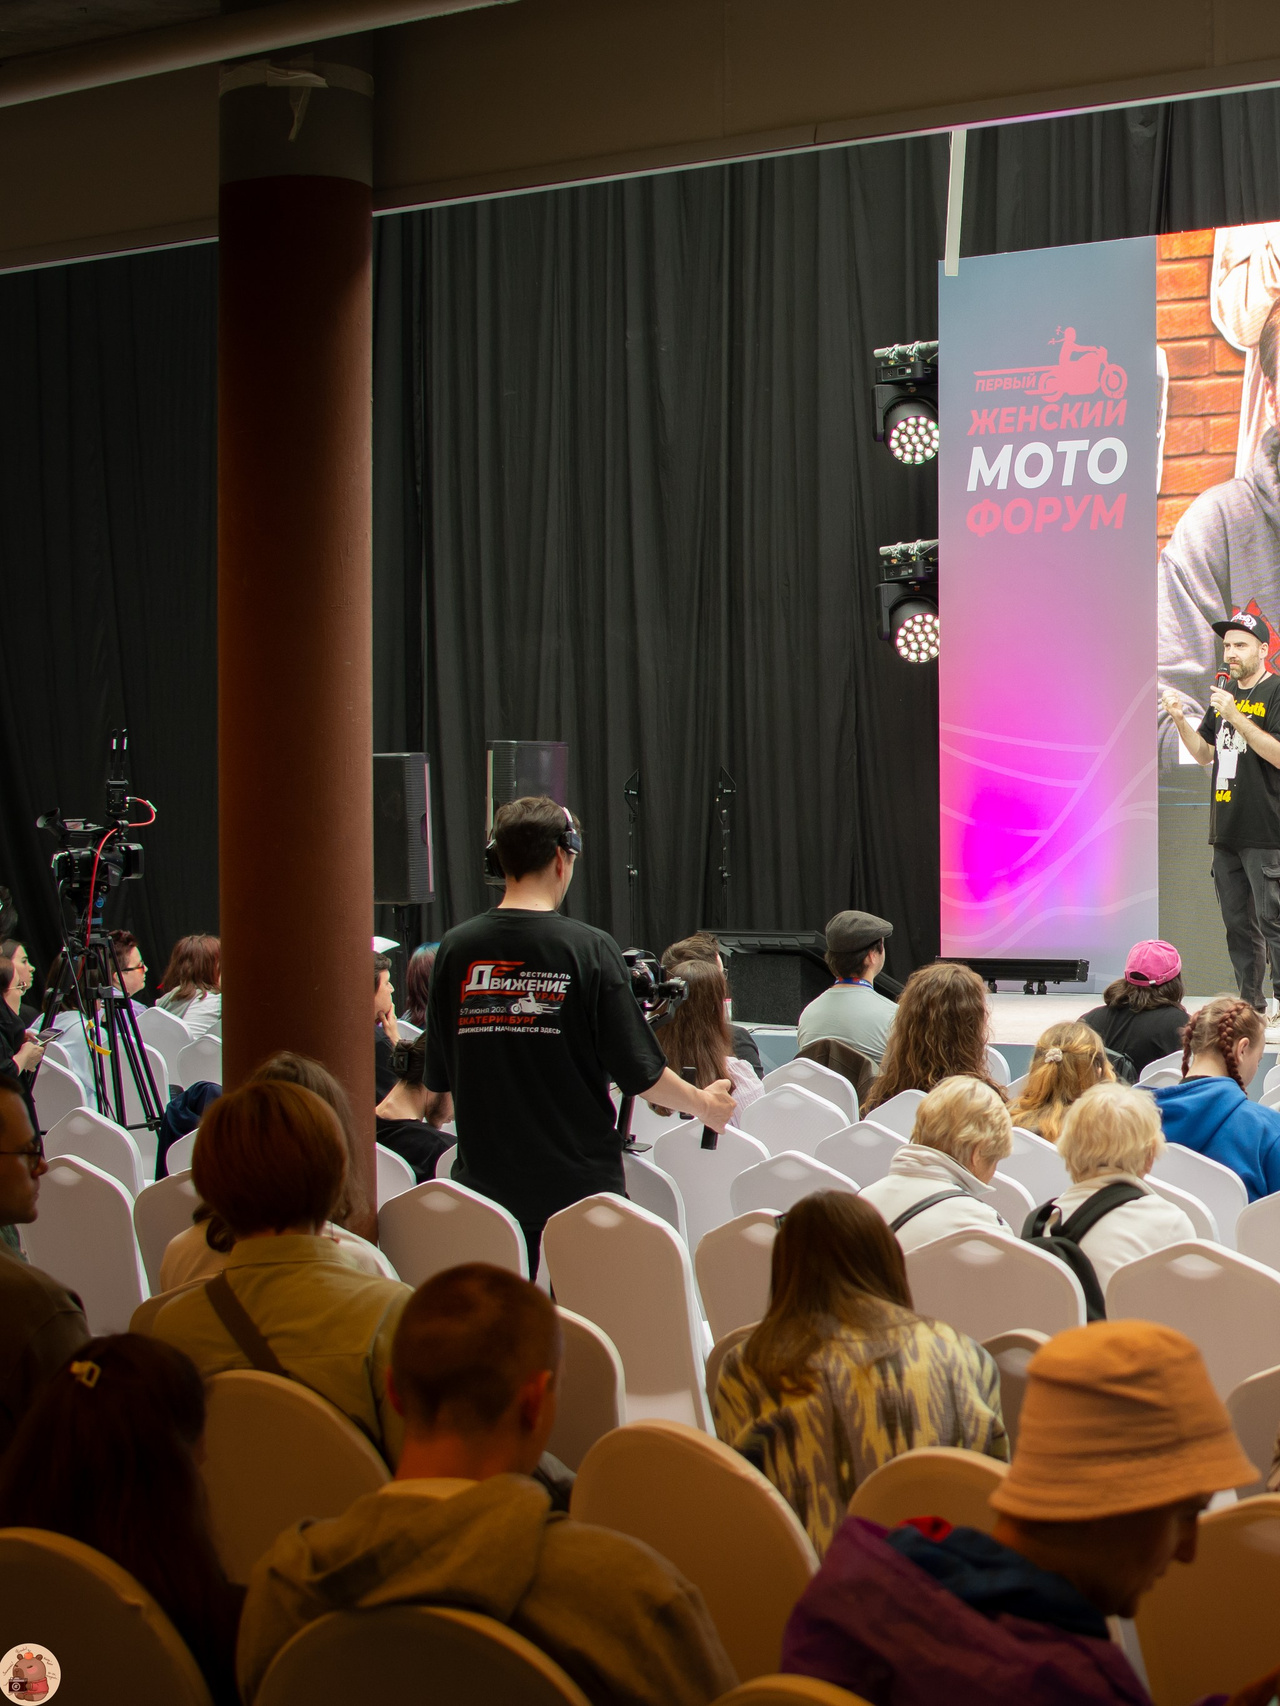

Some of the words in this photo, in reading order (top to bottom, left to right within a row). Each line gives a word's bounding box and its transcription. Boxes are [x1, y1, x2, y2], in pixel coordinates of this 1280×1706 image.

[975, 372, 1037, 393] ПЕРВЫЙ
[966, 437, 1129, 492] МОТО
[966, 493, 1128, 538] ФОРУМ
[465, 965, 572, 993] ДВИЖЕНИЕ
[519, 971, 572, 980] ФЕСТИВАЛЬ
[534, 992, 566, 1002] УРАЛ
[458, 1026, 494, 1035] ДВИЖЕНИЕ
[540, 1027, 562, 1035] ЗДЕСЬ
